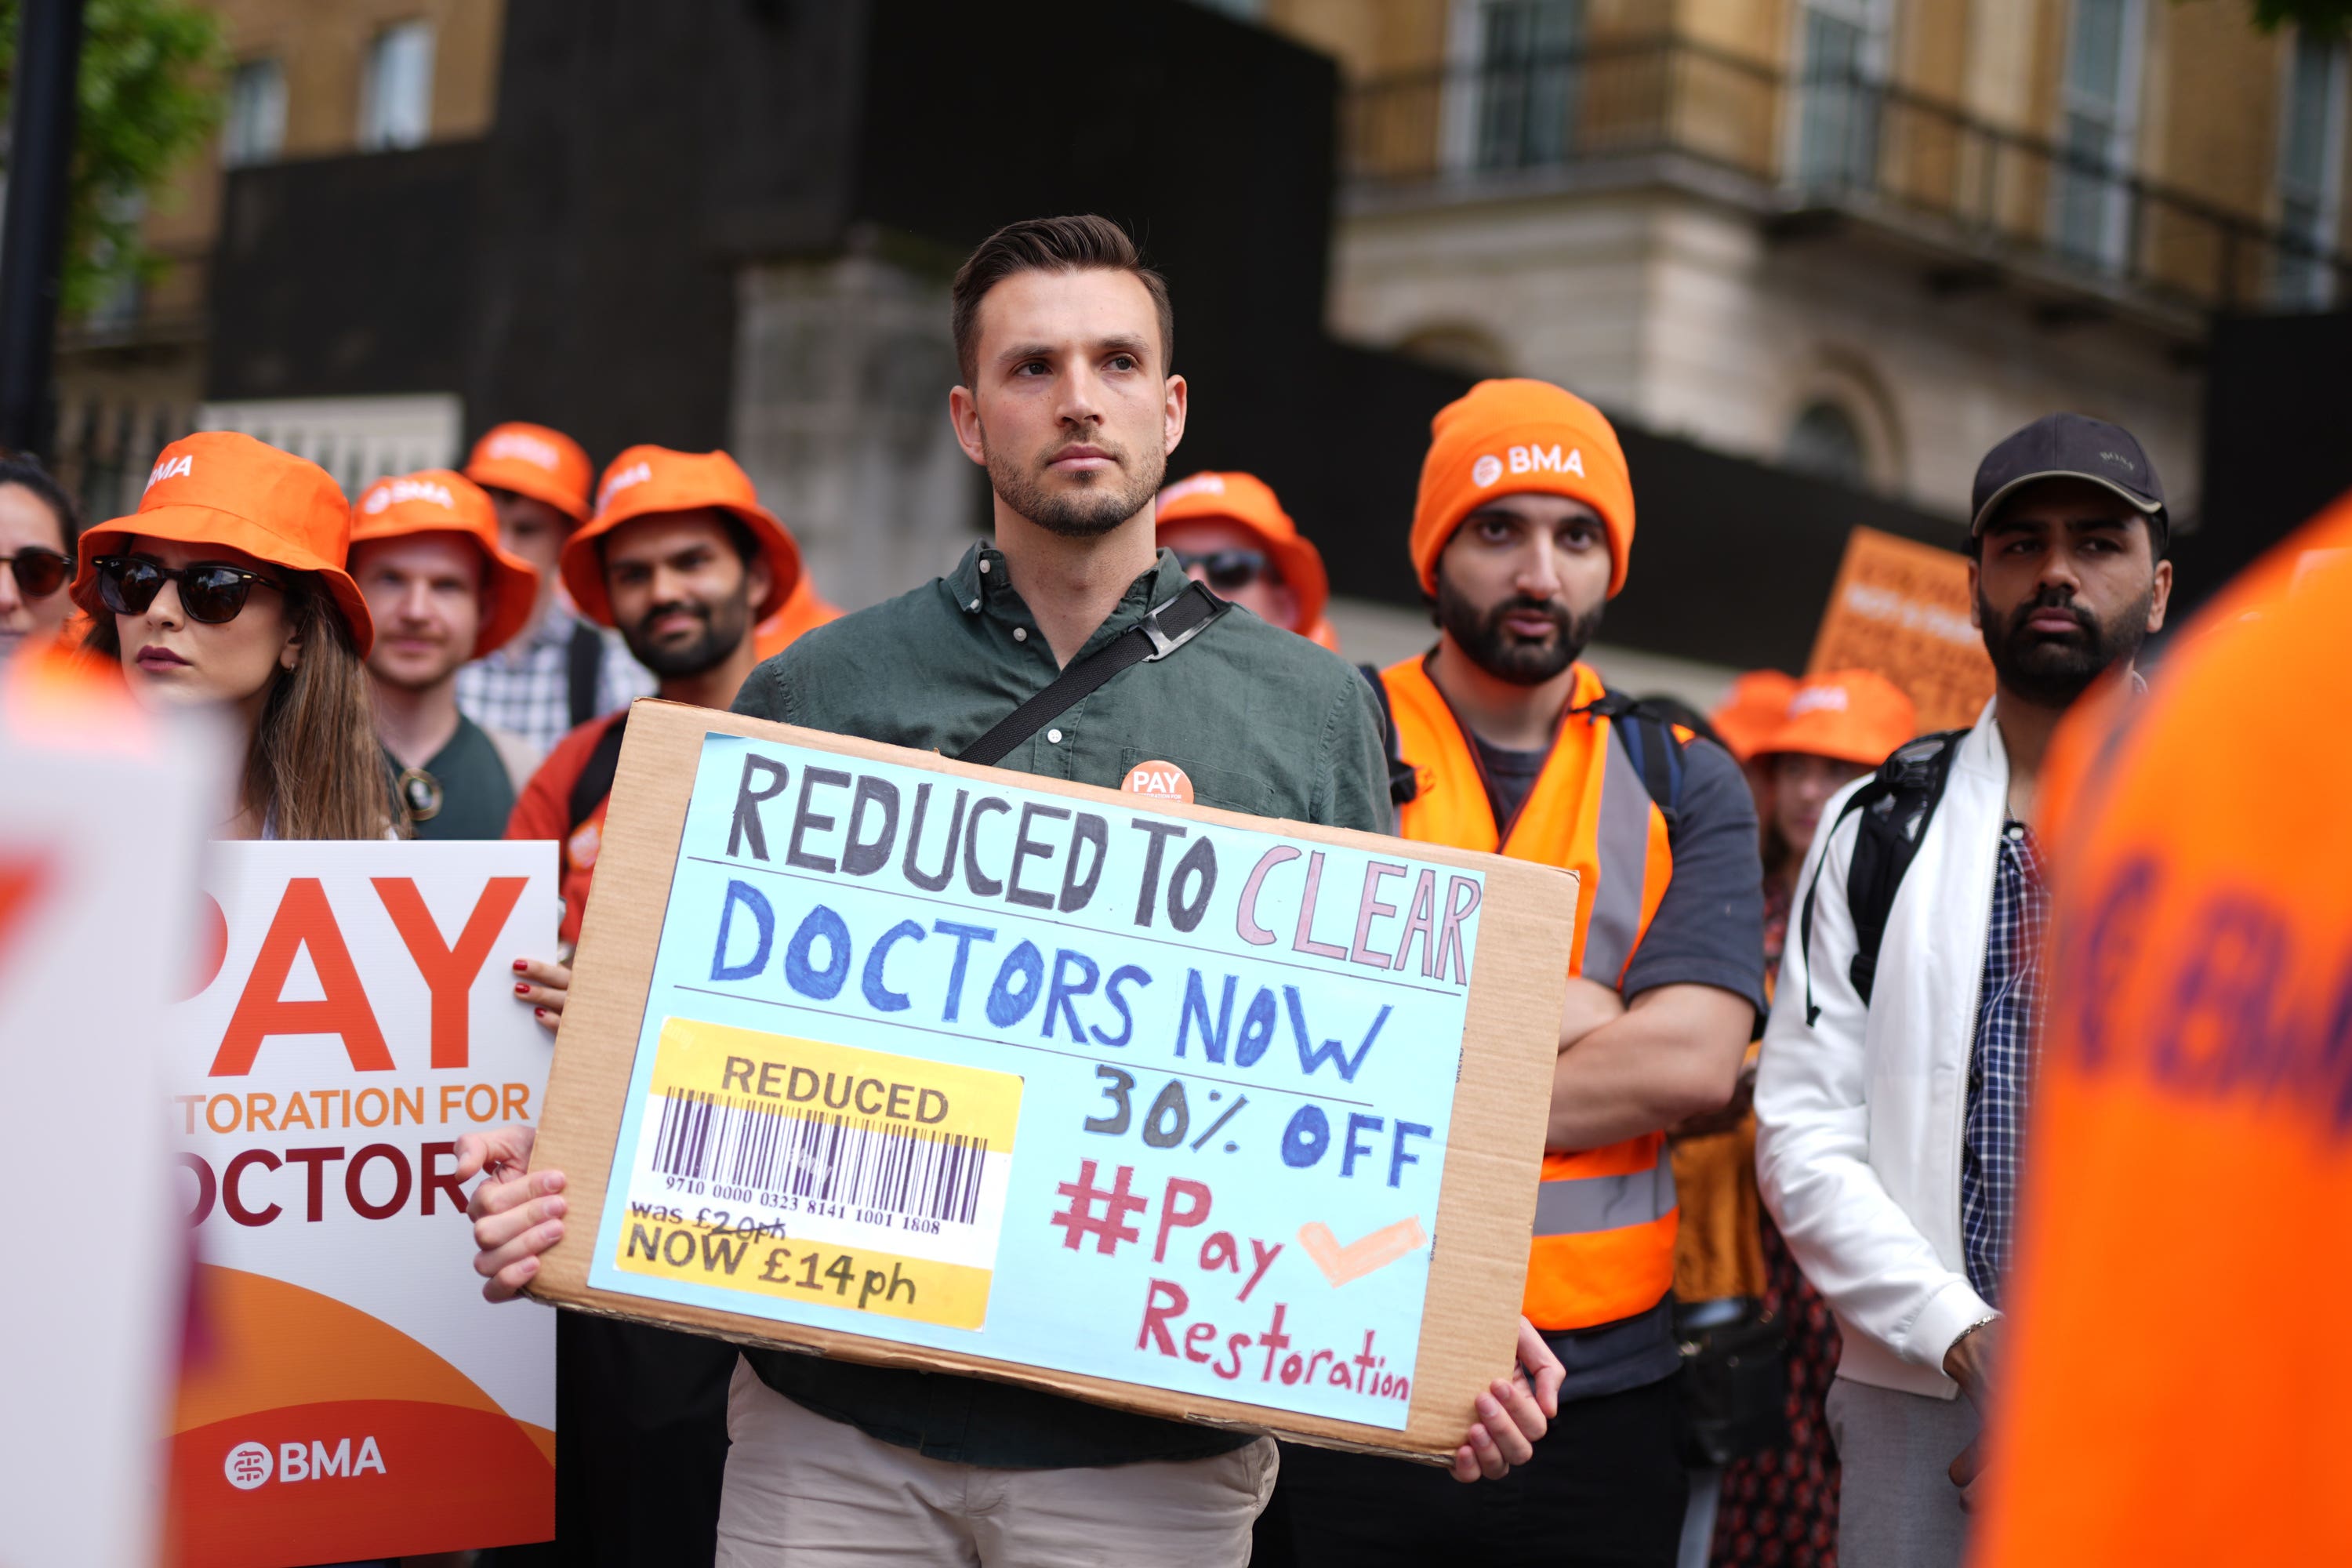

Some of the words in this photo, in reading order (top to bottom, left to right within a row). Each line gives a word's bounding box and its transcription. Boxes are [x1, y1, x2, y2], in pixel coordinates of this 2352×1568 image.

[1508, 444, 1585, 478] BMA
[1133, 771, 1181, 793] PAY
[726, 752, 1109, 913] REDUCED
[1131, 818, 1218, 933] TO
[1236, 844, 1482, 986] CLEAR
[709, 877, 1153, 1048] DOCTORS
[1174, 967, 1394, 1083] NOW
[176, 1087, 423, 1134] TORATION
[440, 1083, 530, 1123] FOR
[722, 1055, 949, 1124] REDUCED
[1083, 1064, 1250, 1153] 30%
[1279, 1103, 1433, 1188] OFF
[176, 1142, 470, 1229] OCTOR
[632, 1201, 683, 1225] was
[666, 1176, 705, 1196] 9710
[713, 1184, 753, 1203] 0000
[760, 1192, 798, 1210] 0323
[808, 1201, 845, 1219] 8141
[855, 1210, 892, 1227] 1001
[902, 1217, 940, 1235] 1808
[627, 1223, 748, 1275] NOW
[1050, 1157, 1285, 1302] #Pay
[1135, 1277, 1409, 1401] Restoration
[279, 1436, 387, 1483] BMA
